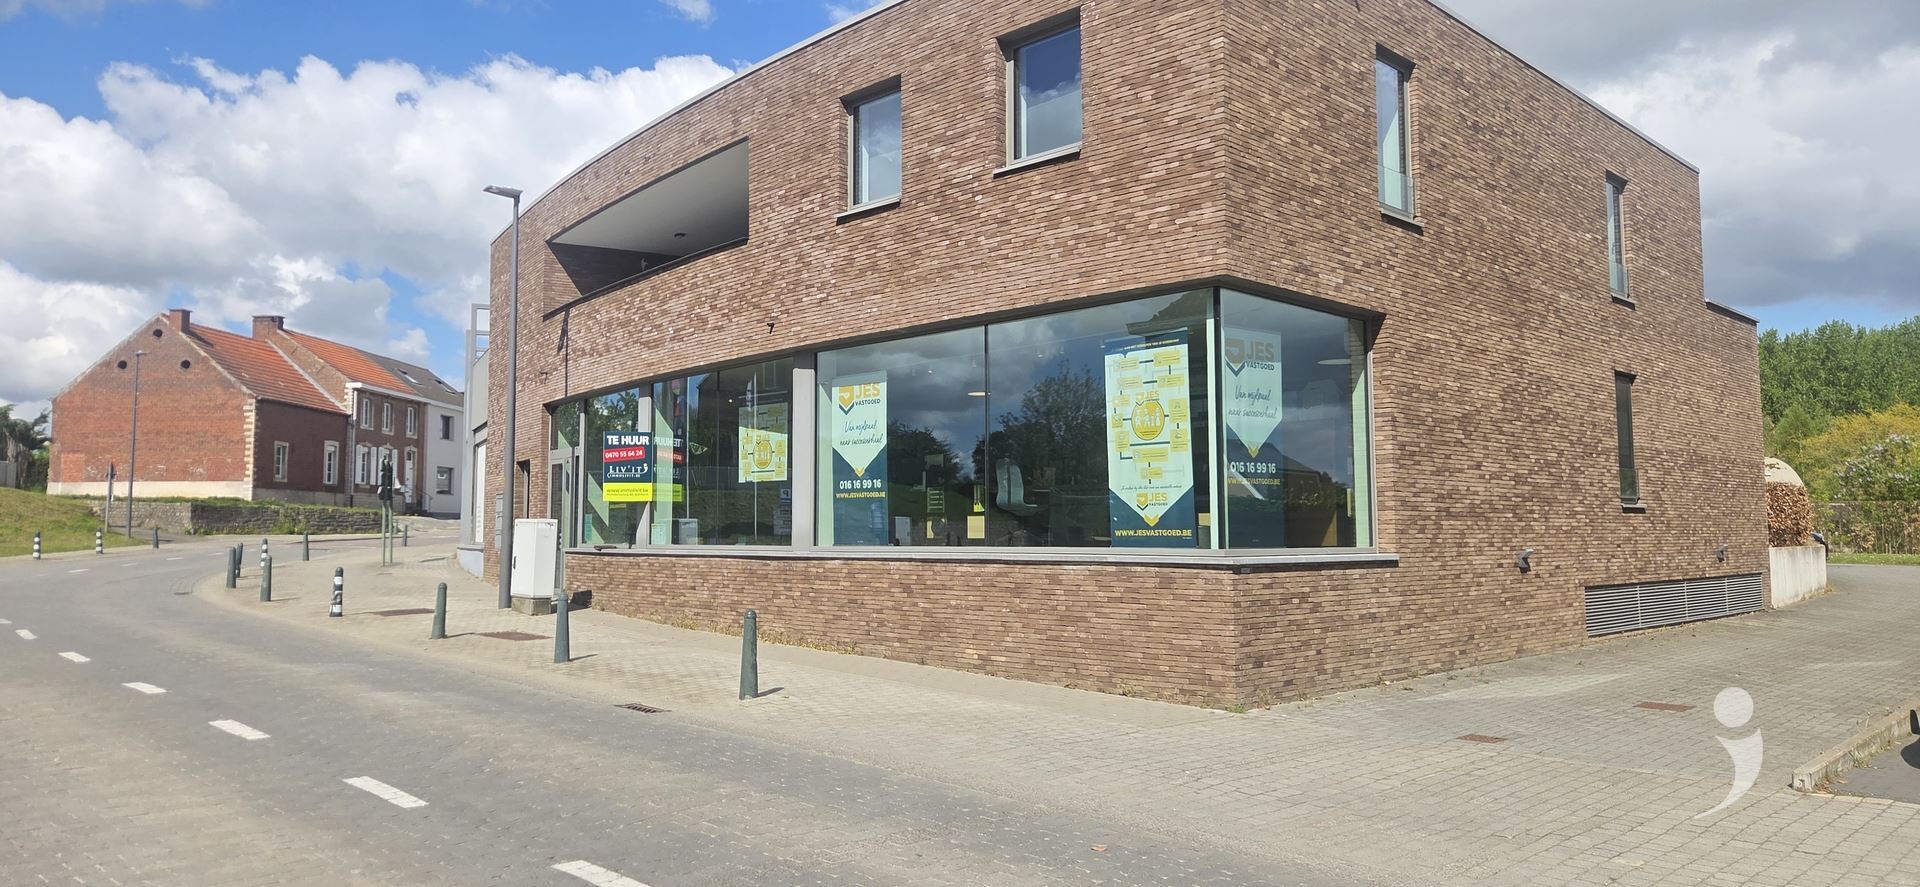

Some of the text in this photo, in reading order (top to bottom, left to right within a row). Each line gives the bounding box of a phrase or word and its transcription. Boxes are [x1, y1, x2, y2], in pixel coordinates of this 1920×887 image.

[1247, 341, 1275, 362] JES
[1245, 361, 1275, 371] VASTGOED
[855, 383, 881, 399] JES
[855, 398, 881, 406] VASTGOED
[606, 435, 650, 446] TE HUUR
[605, 451, 619, 459] 0470
[1230, 461, 1277, 474] 016 16 99 16
[839, 479, 882, 490] 016 16 99 16
[1148, 492, 1168, 502] JES
[1114, 529, 1193, 537] WWW.JESVASTGOED.BE
